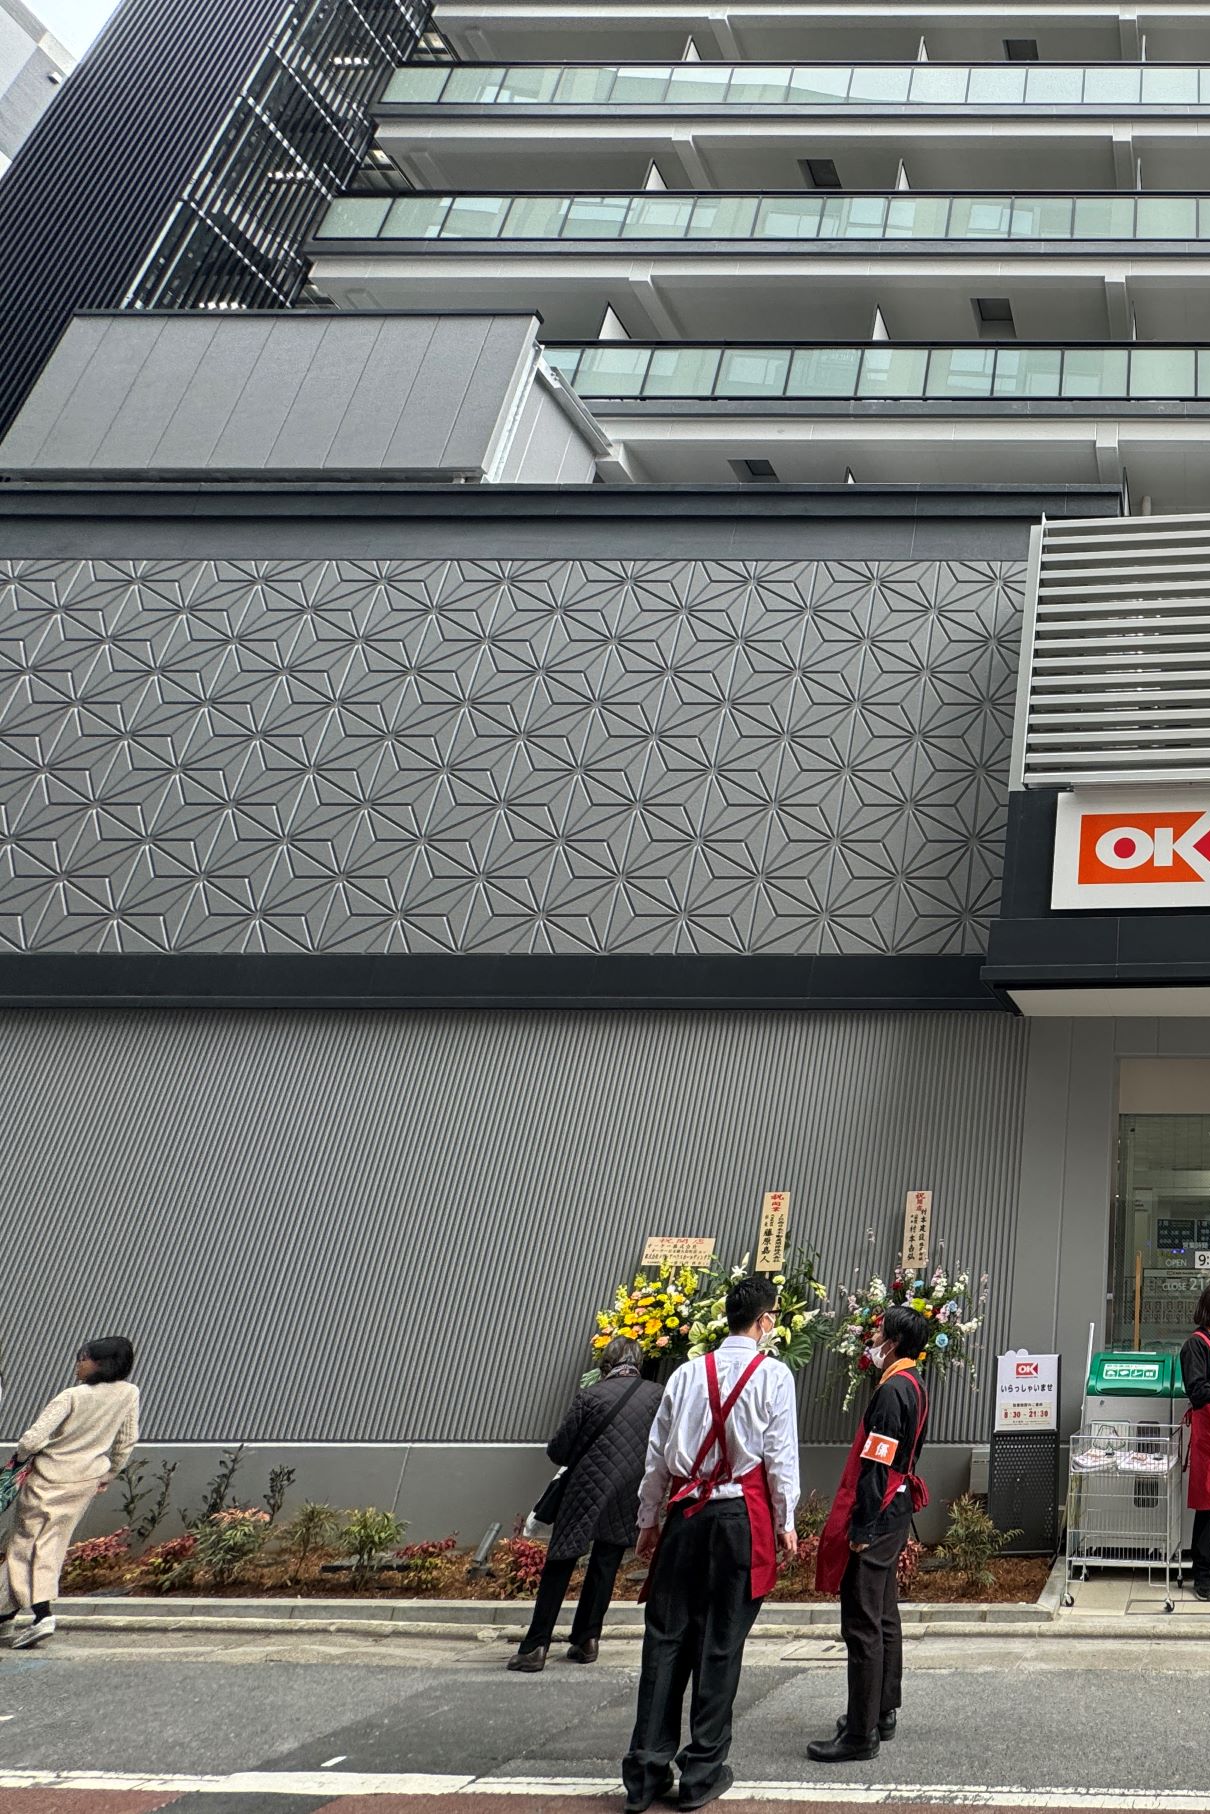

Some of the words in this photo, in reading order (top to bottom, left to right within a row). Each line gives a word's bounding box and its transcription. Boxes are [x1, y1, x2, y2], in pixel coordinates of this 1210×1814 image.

[1016, 1362, 1039, 1376] OK
[1001, 1384, 1053, 1392] いらっしゃいませ
